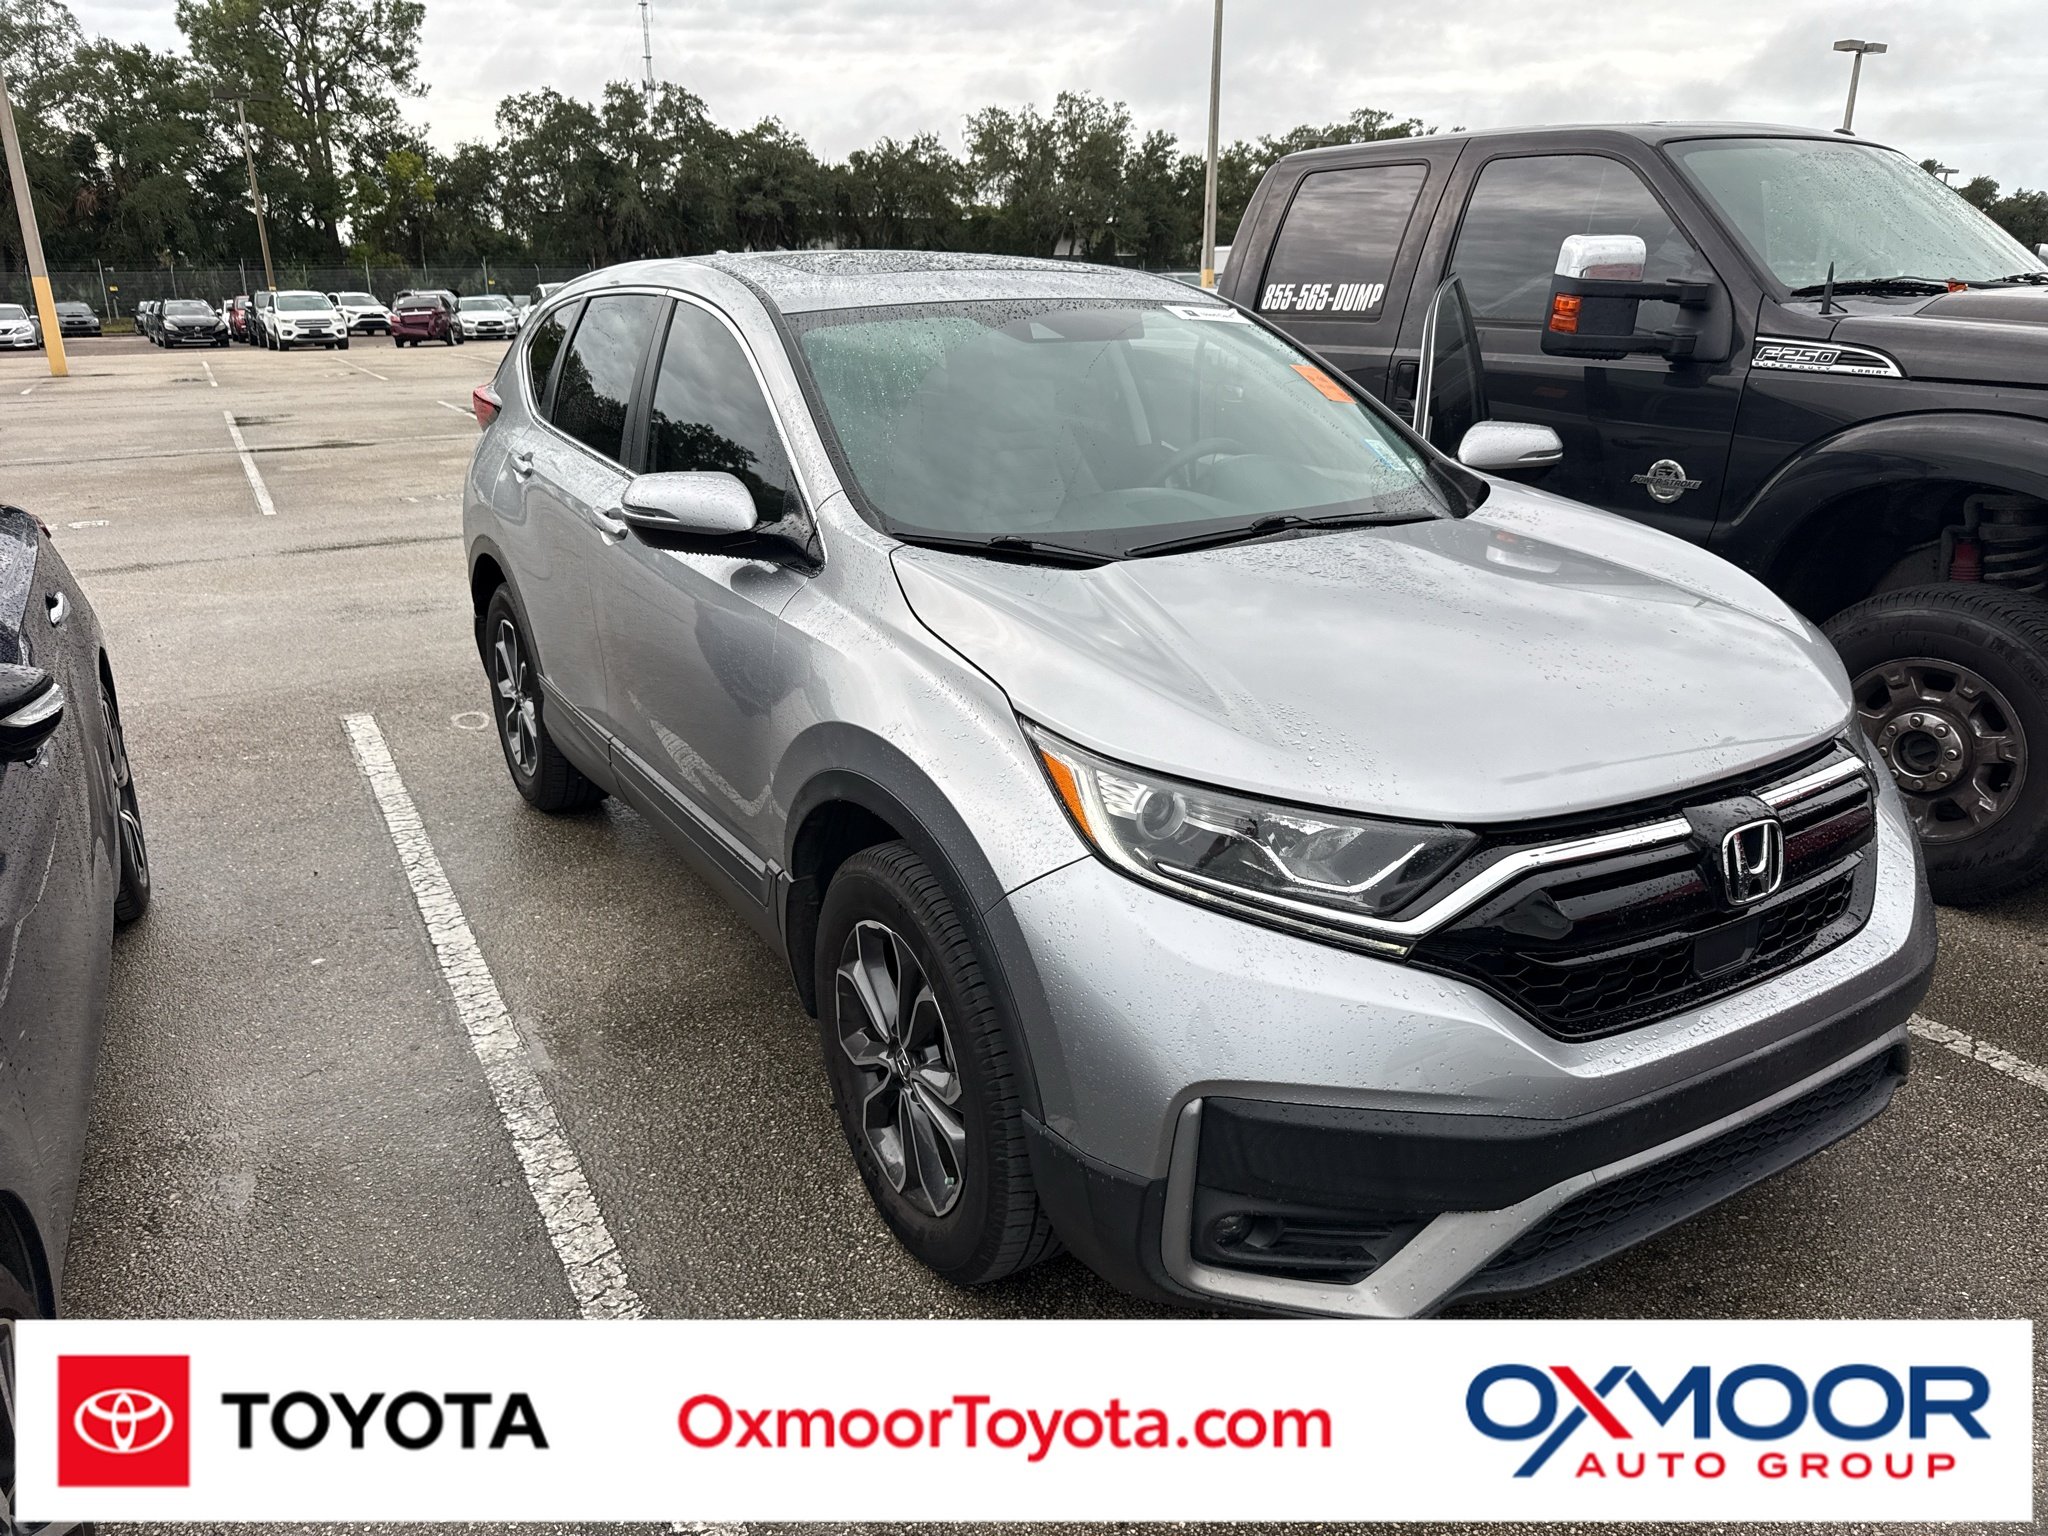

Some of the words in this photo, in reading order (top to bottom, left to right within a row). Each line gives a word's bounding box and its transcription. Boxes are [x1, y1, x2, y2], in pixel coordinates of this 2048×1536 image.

[1262, 283, 1385, 312] 855-565-DUMP
[1756, 346, 1841, 365] F-250
[1754, 361, 1793, 369] SUPER
[1799, 364, 1831, 372] DUTY
